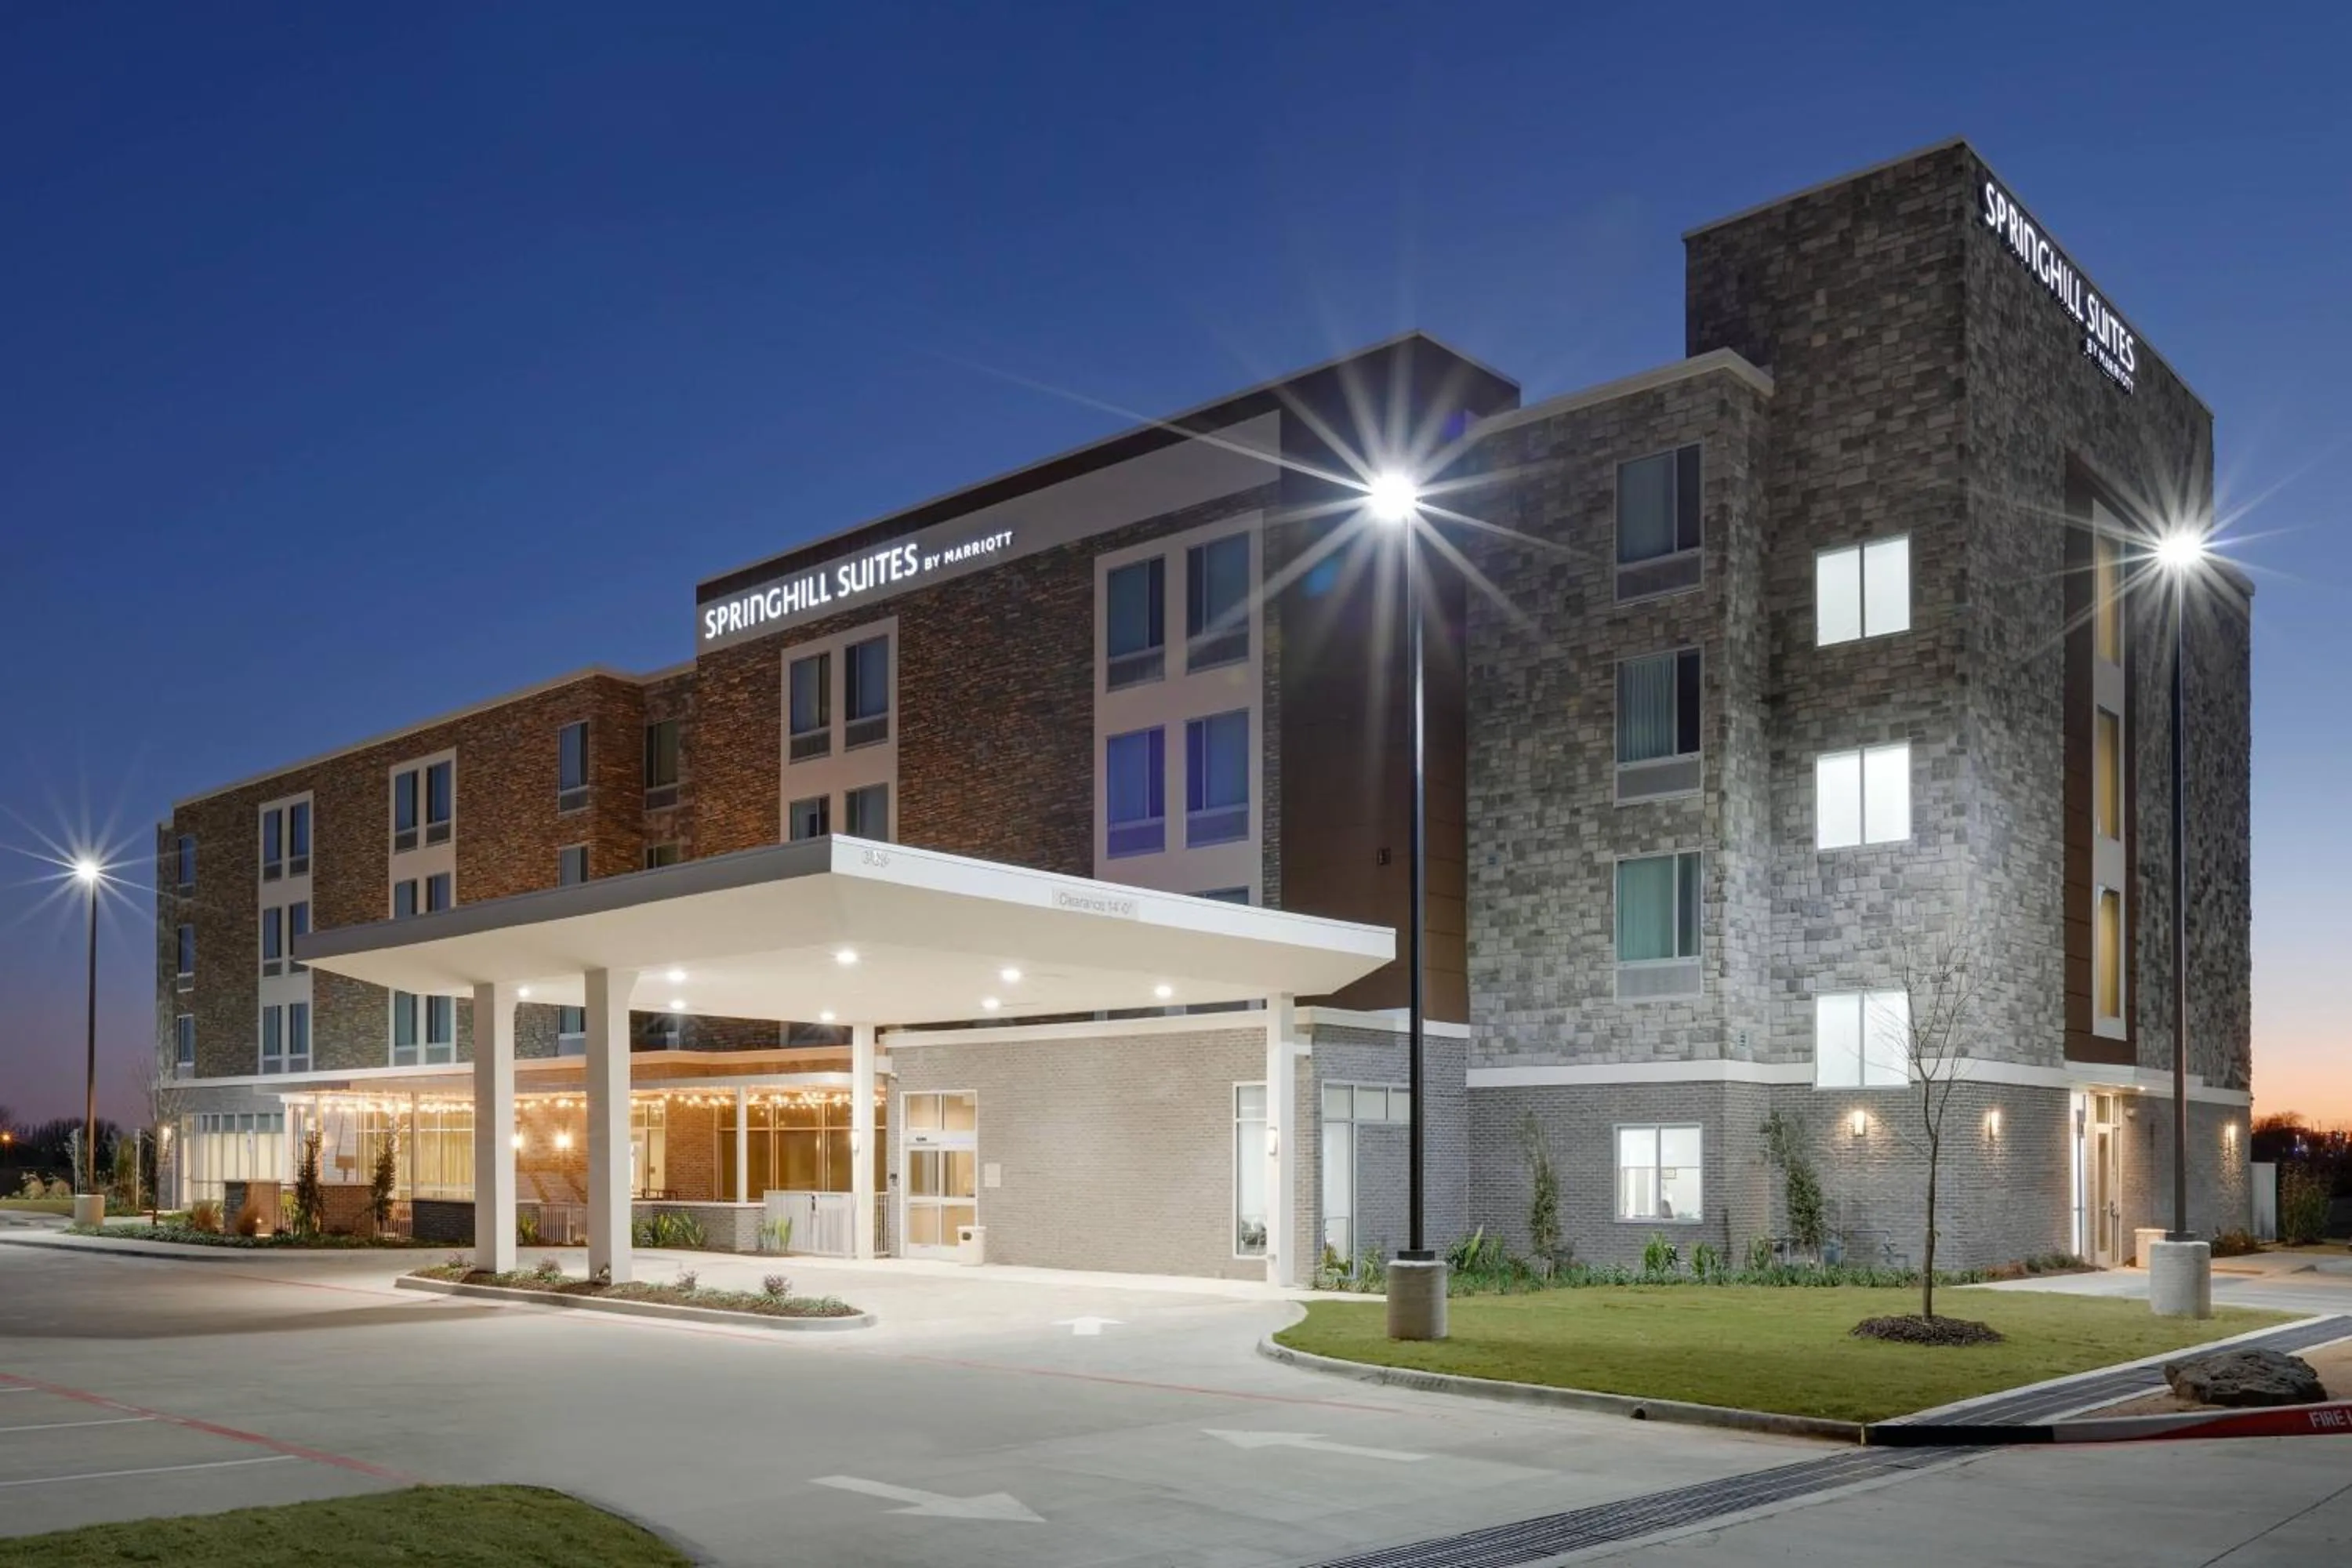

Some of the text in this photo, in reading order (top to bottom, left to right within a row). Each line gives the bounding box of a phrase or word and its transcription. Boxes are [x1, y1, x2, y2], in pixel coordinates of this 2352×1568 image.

[1985, 182, 2135, 372] SPRINGHILL SUITES
[2086, 337, 2098, 358] BY
[705, 531, 1013, 641] SPRINGHILL SUITES BY MARRIOTT
[2309, 1410, 2346, 1428] FIRE
